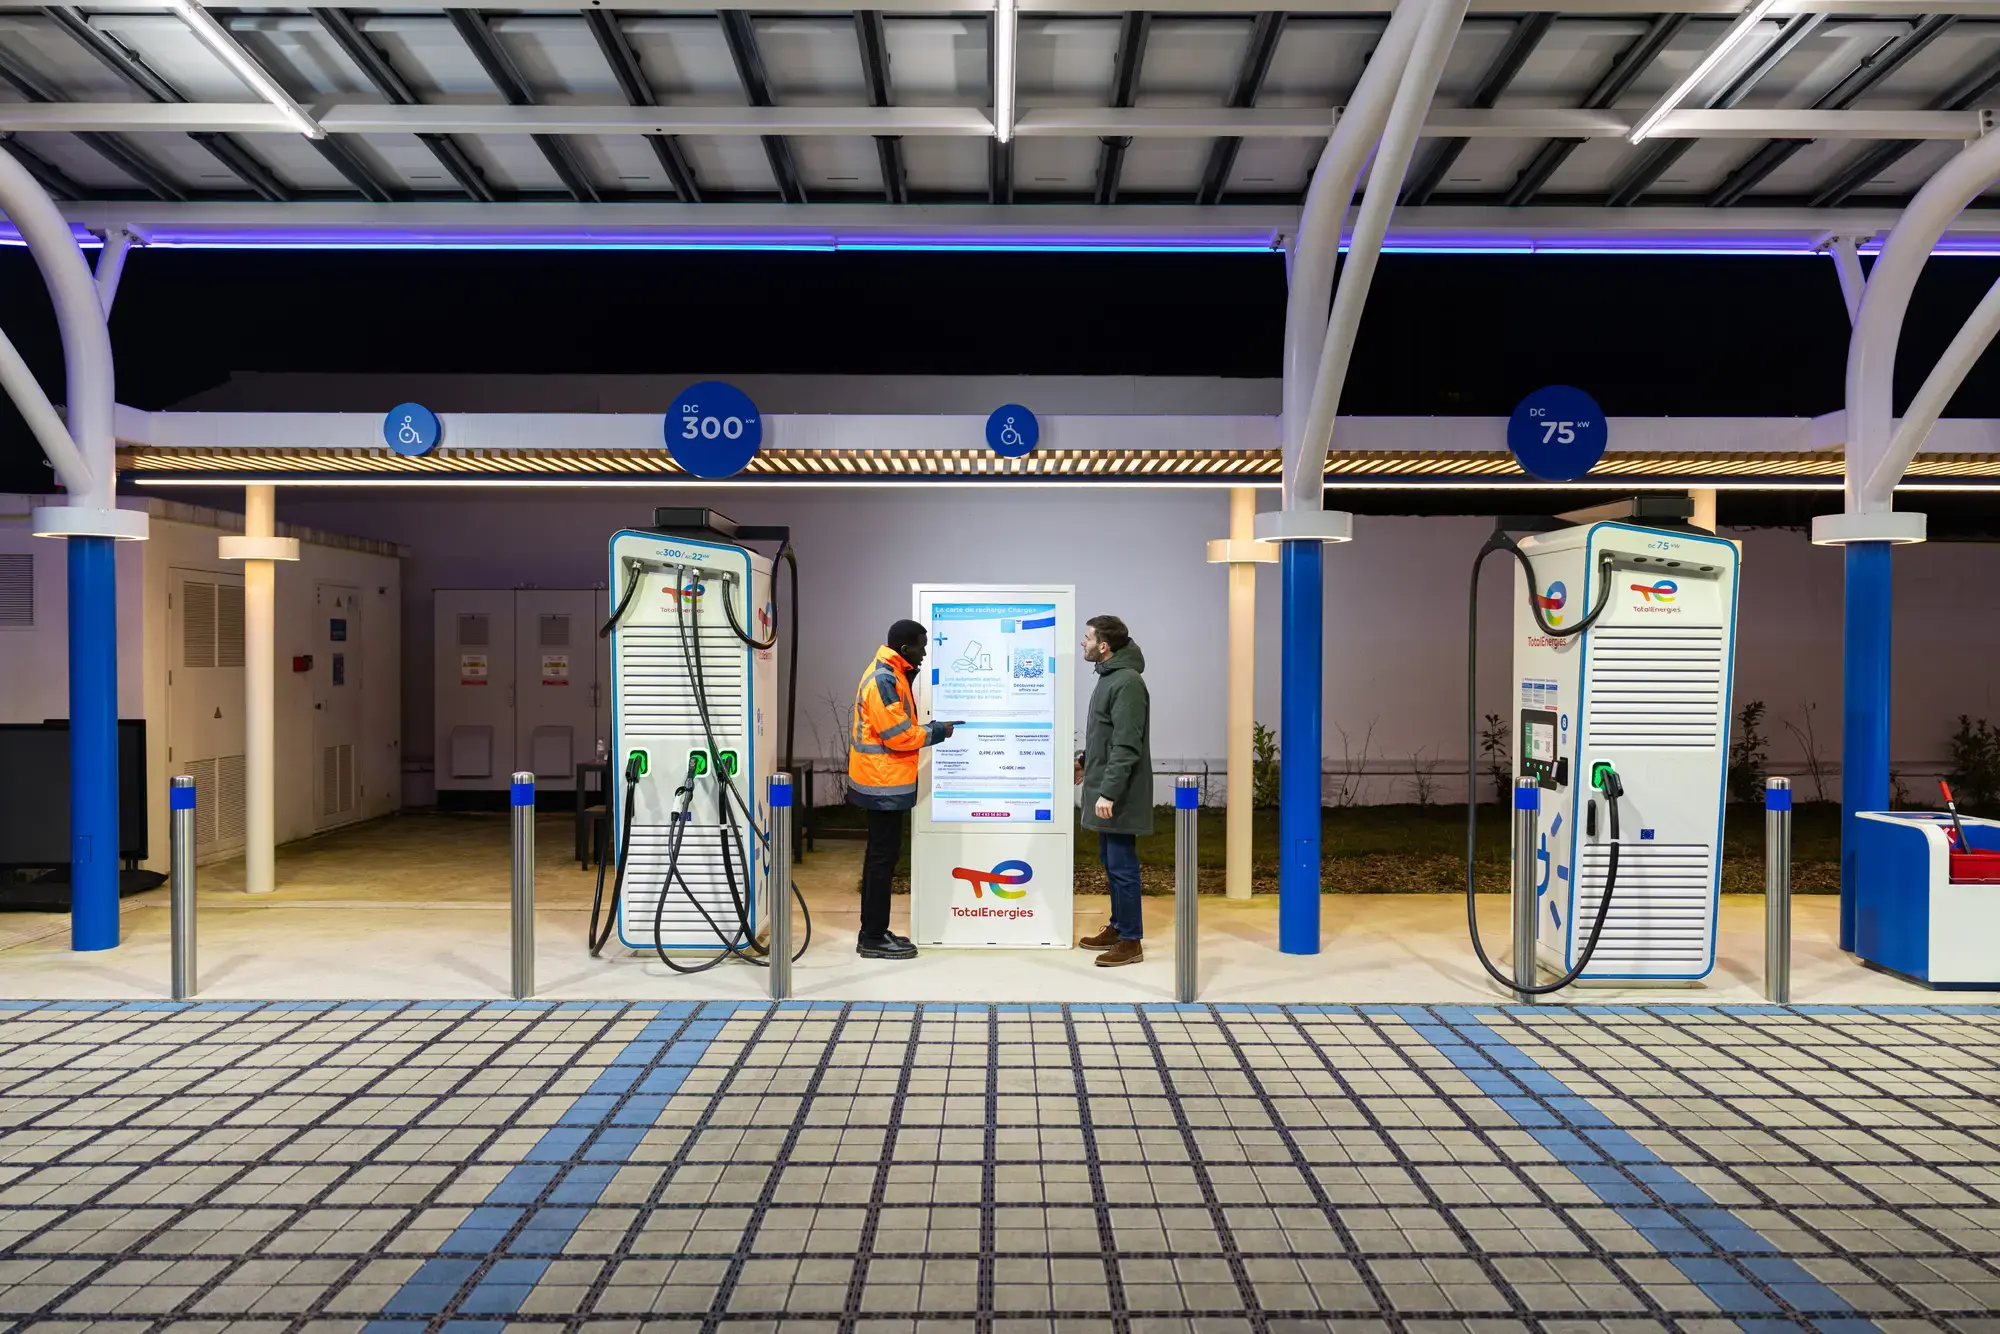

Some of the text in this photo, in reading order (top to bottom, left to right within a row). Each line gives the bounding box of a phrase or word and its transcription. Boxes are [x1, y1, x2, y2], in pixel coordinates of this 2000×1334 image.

[682, 404, 699, 413] DC
[1529, 408, 1546, 417] DC
[682, 416, 743, 439] 300
[1540, 421, 1575, 444] 75
[1657, 540, 1669, 550] 75
[975, 606, 1006, 614] recharge
[1633, 606, 1681, 614] TotalEnergies
[1527, 636, 1567, 649] TotalEnergies
[951, 907, 1034, 920] TotalEnergies
